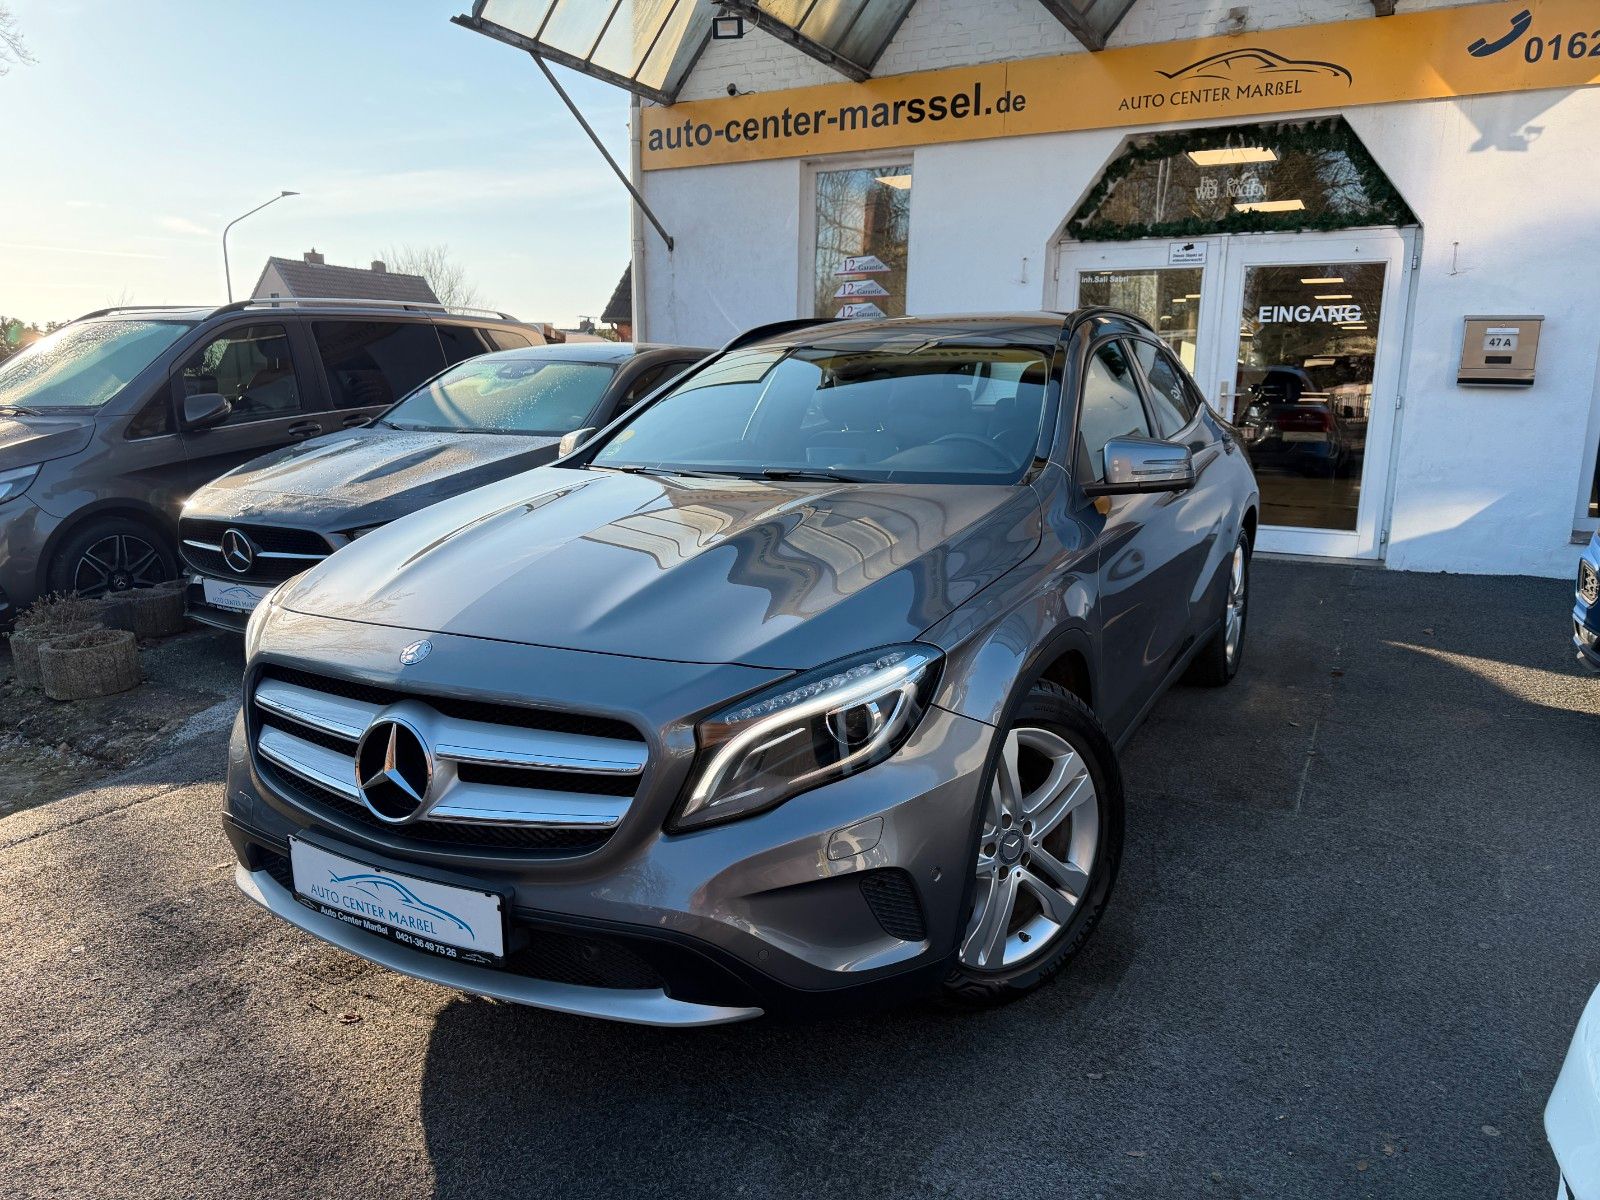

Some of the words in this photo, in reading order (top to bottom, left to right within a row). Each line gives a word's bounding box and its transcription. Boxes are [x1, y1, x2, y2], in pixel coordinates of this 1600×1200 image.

[1524, 29, 1600, 64] 0162
[1118, 93, 1165, 111] AUTO
[1170, 86, 1231, 106] CENTER
[648, 82, 1027, 151] auto-center-marssel.de
[844, 259, 855, 271] 12
[842, 283, 854, 295] 12
[841, 306, 854, 317] 12
[1259, 304, 1362, 323] EINGANG
[1489, 338, 1501, 347] 47
[1503, 338, 1511, 347] A
[311, 884, 339, 904] AUTO
[342, 895, 386, 920] CENTER
[320, 905, 337, 919] Auto
[337, 911, 363, 927] Center
[435, 944, 446, 955] 75
[446, 947, 457, 958] 26
